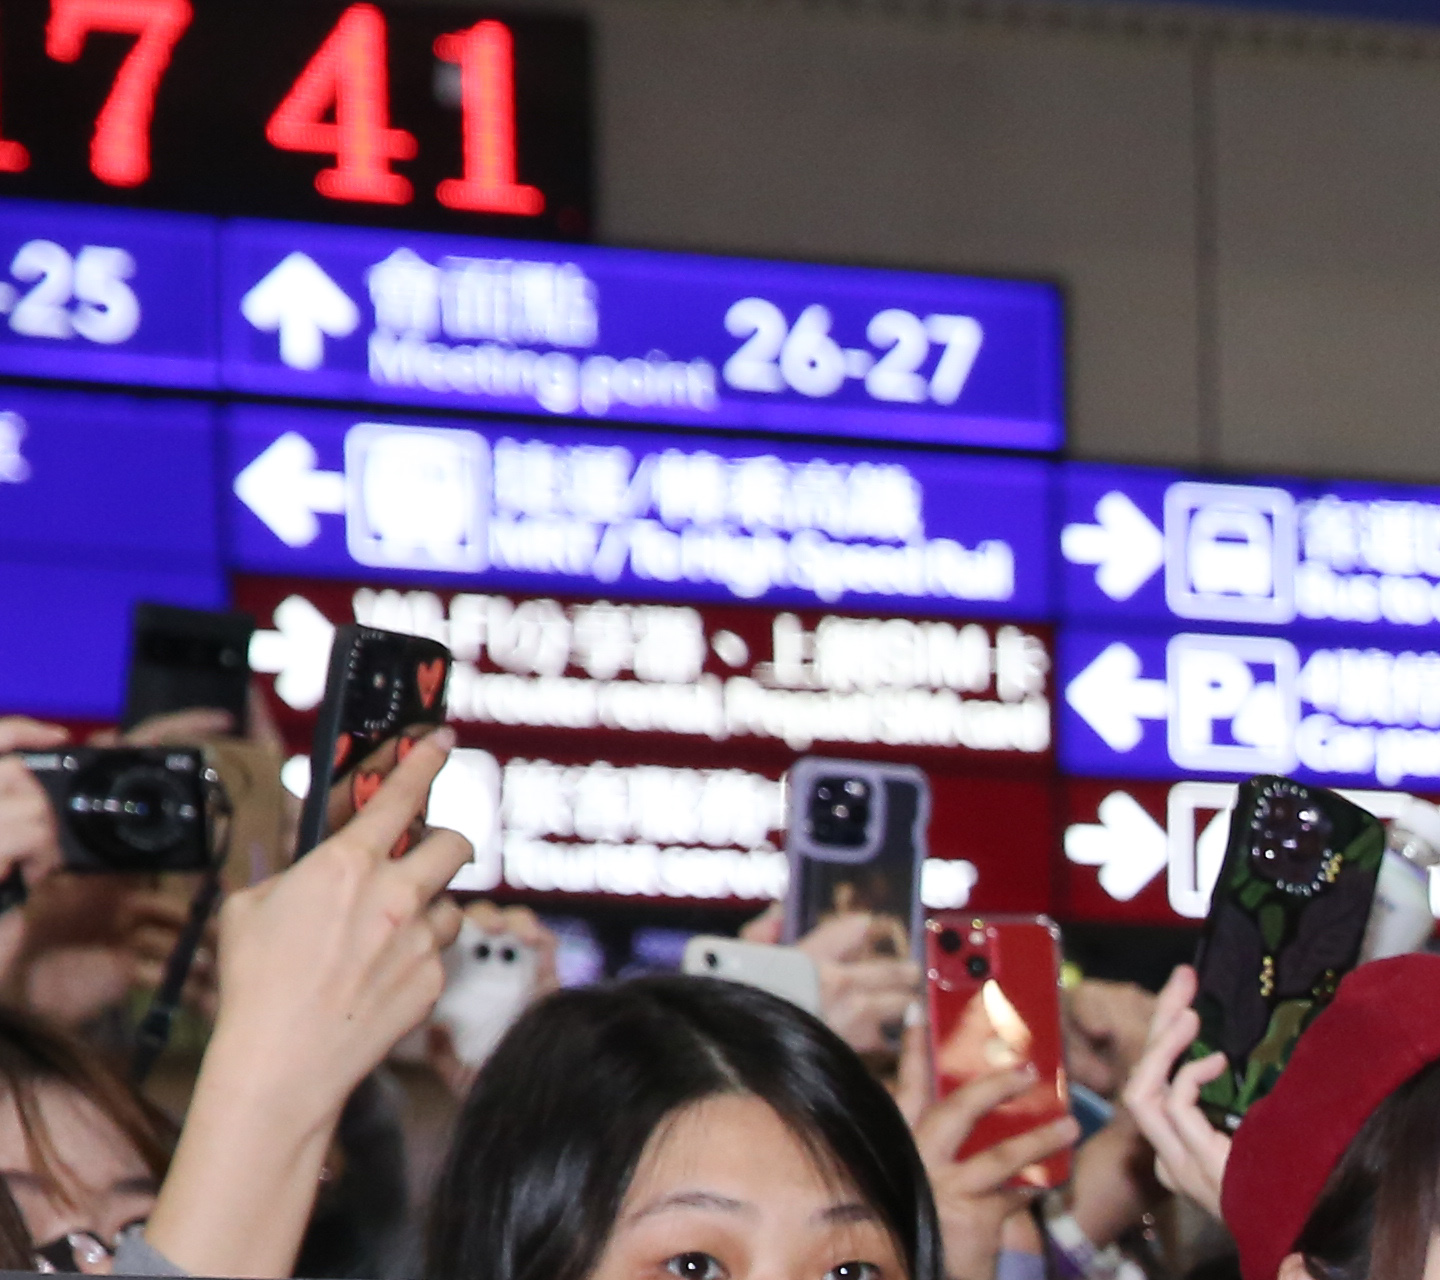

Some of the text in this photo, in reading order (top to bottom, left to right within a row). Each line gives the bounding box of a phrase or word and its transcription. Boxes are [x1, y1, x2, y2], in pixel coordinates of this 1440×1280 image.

[0, 0, 546, 216] 7 41
[368, 330, 720, 416] Meeting point
[723, 296, 983, 406] 26-27
